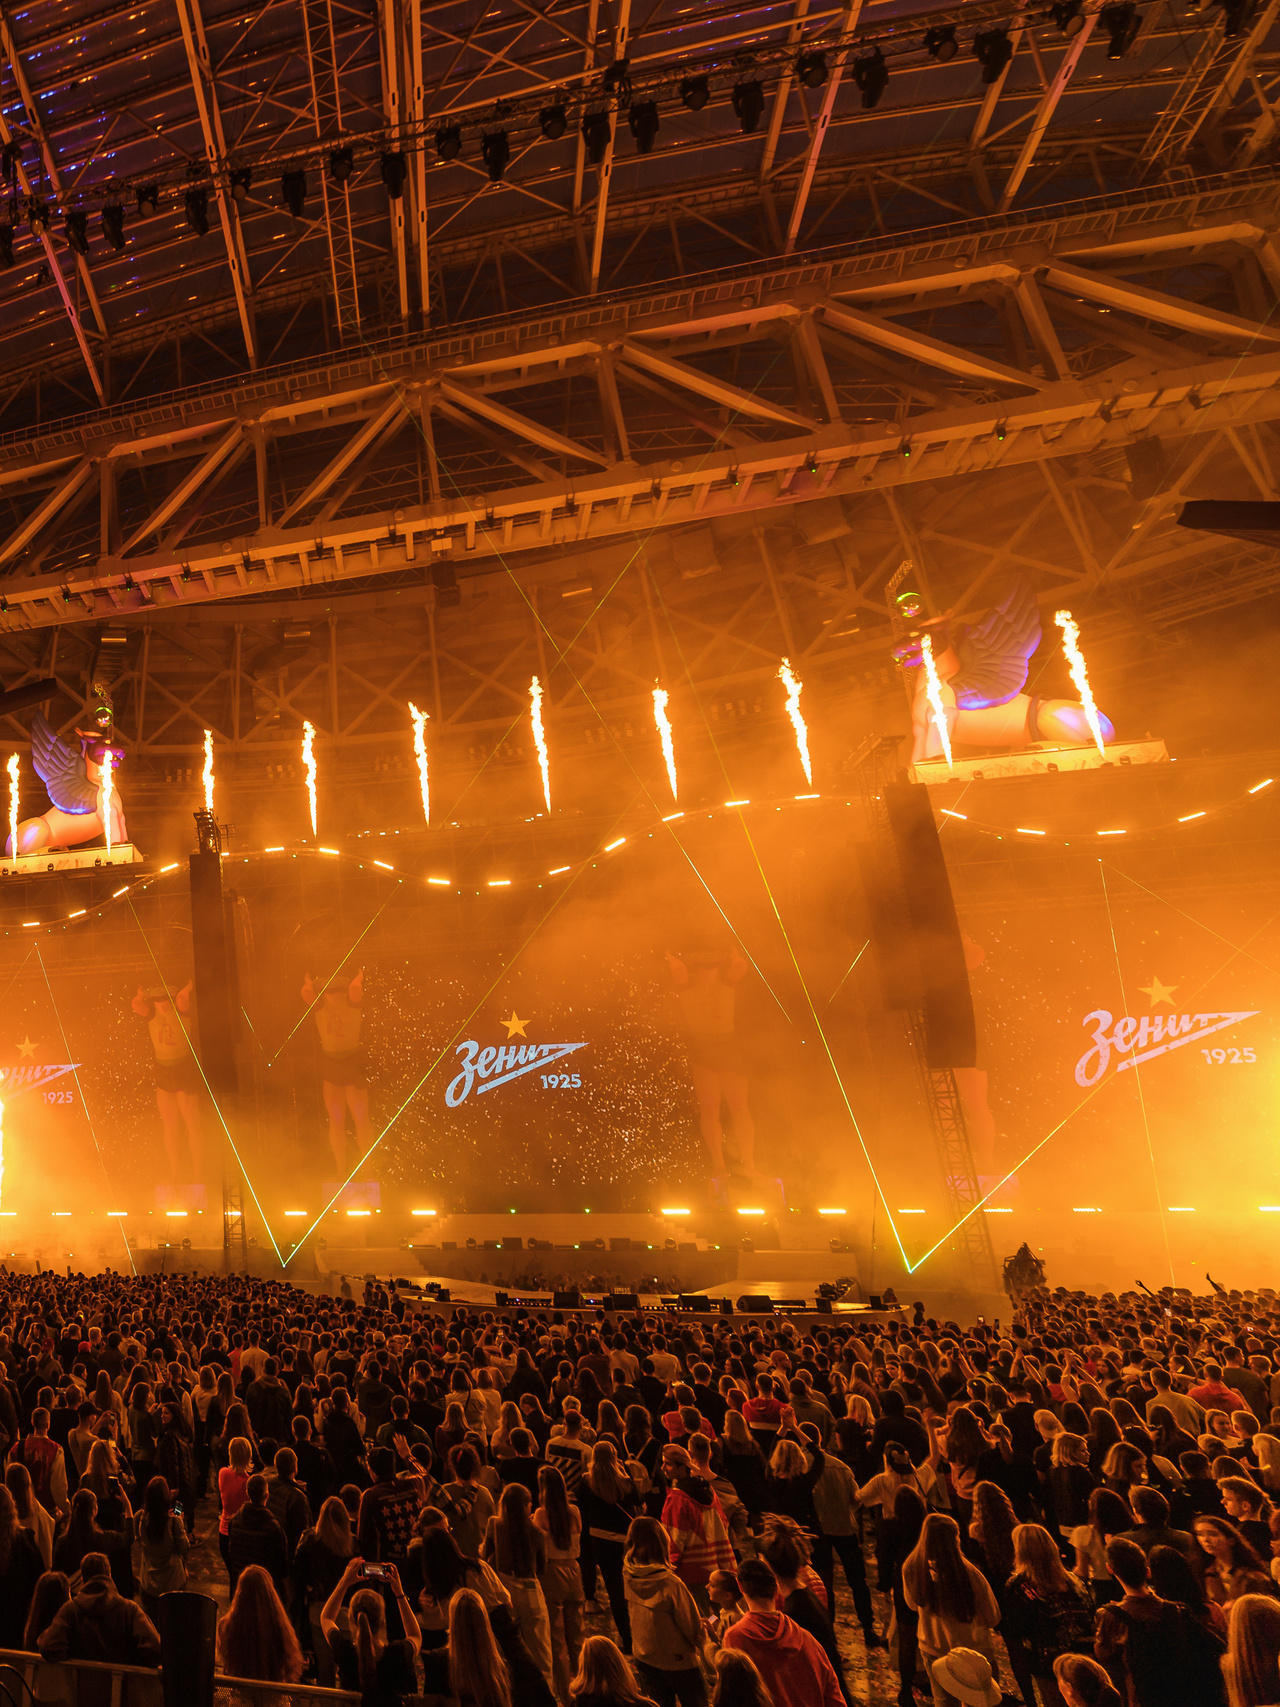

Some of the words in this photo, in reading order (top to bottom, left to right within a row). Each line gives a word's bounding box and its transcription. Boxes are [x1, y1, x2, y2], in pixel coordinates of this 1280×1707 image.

[1074, 1010, 1263, 1088] Зенит
[1201, 1047, 1257, 1065] 1925
[445, 1040, 590, 1108] Зенит
[540, 1073, 582, 1089] 1925
[42, 1091, 74, 1104] 1925
